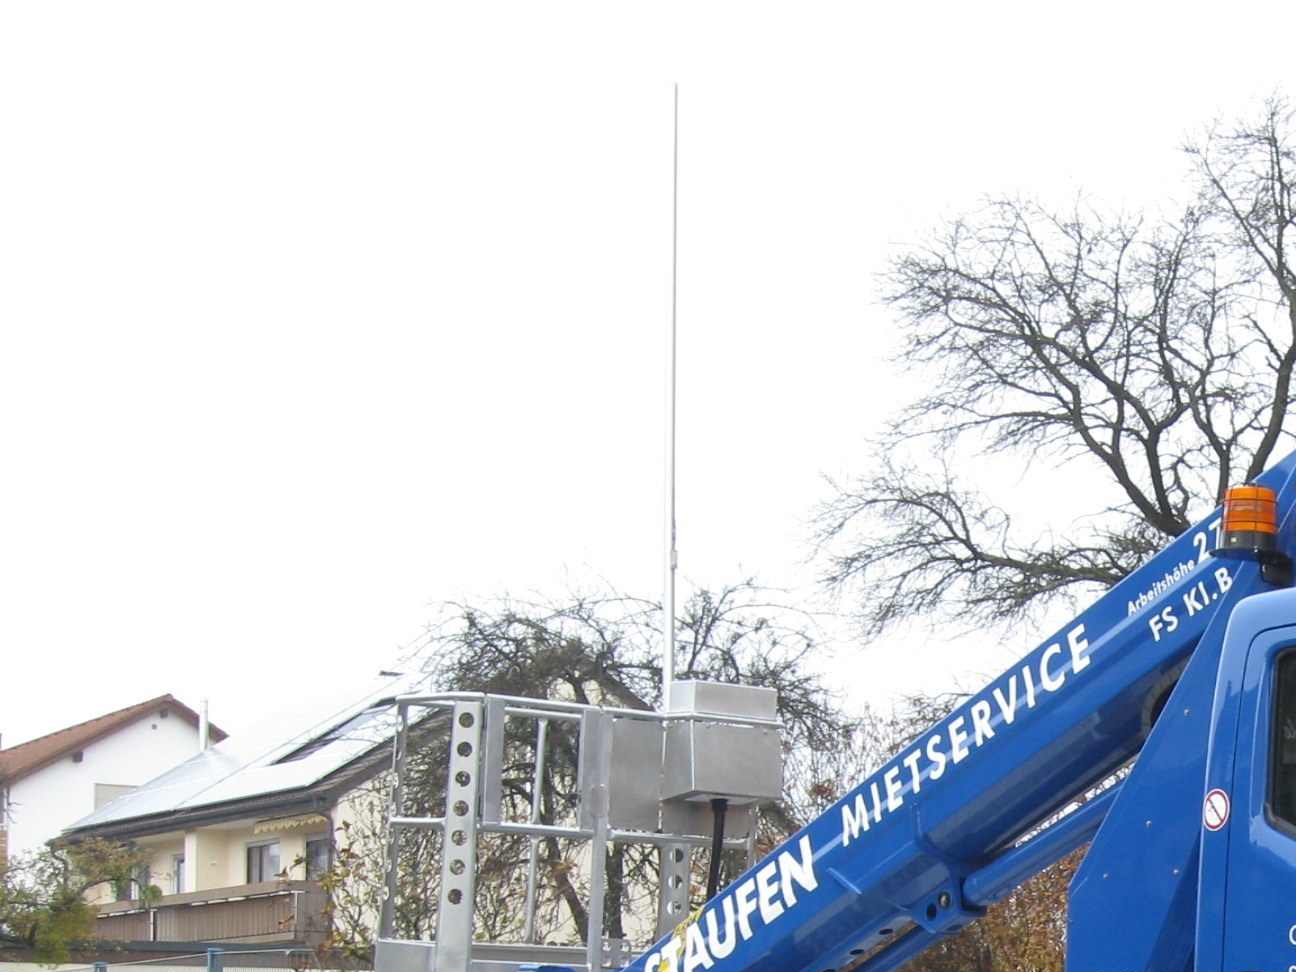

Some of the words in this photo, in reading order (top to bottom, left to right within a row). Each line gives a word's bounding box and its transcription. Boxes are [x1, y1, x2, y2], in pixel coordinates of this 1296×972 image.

[1127, 559, 1195, 616] Arbeitshöhe
[1148, 605, 1179, 642] FS
[841, 623, 1091, 847] MIETSERVICE
